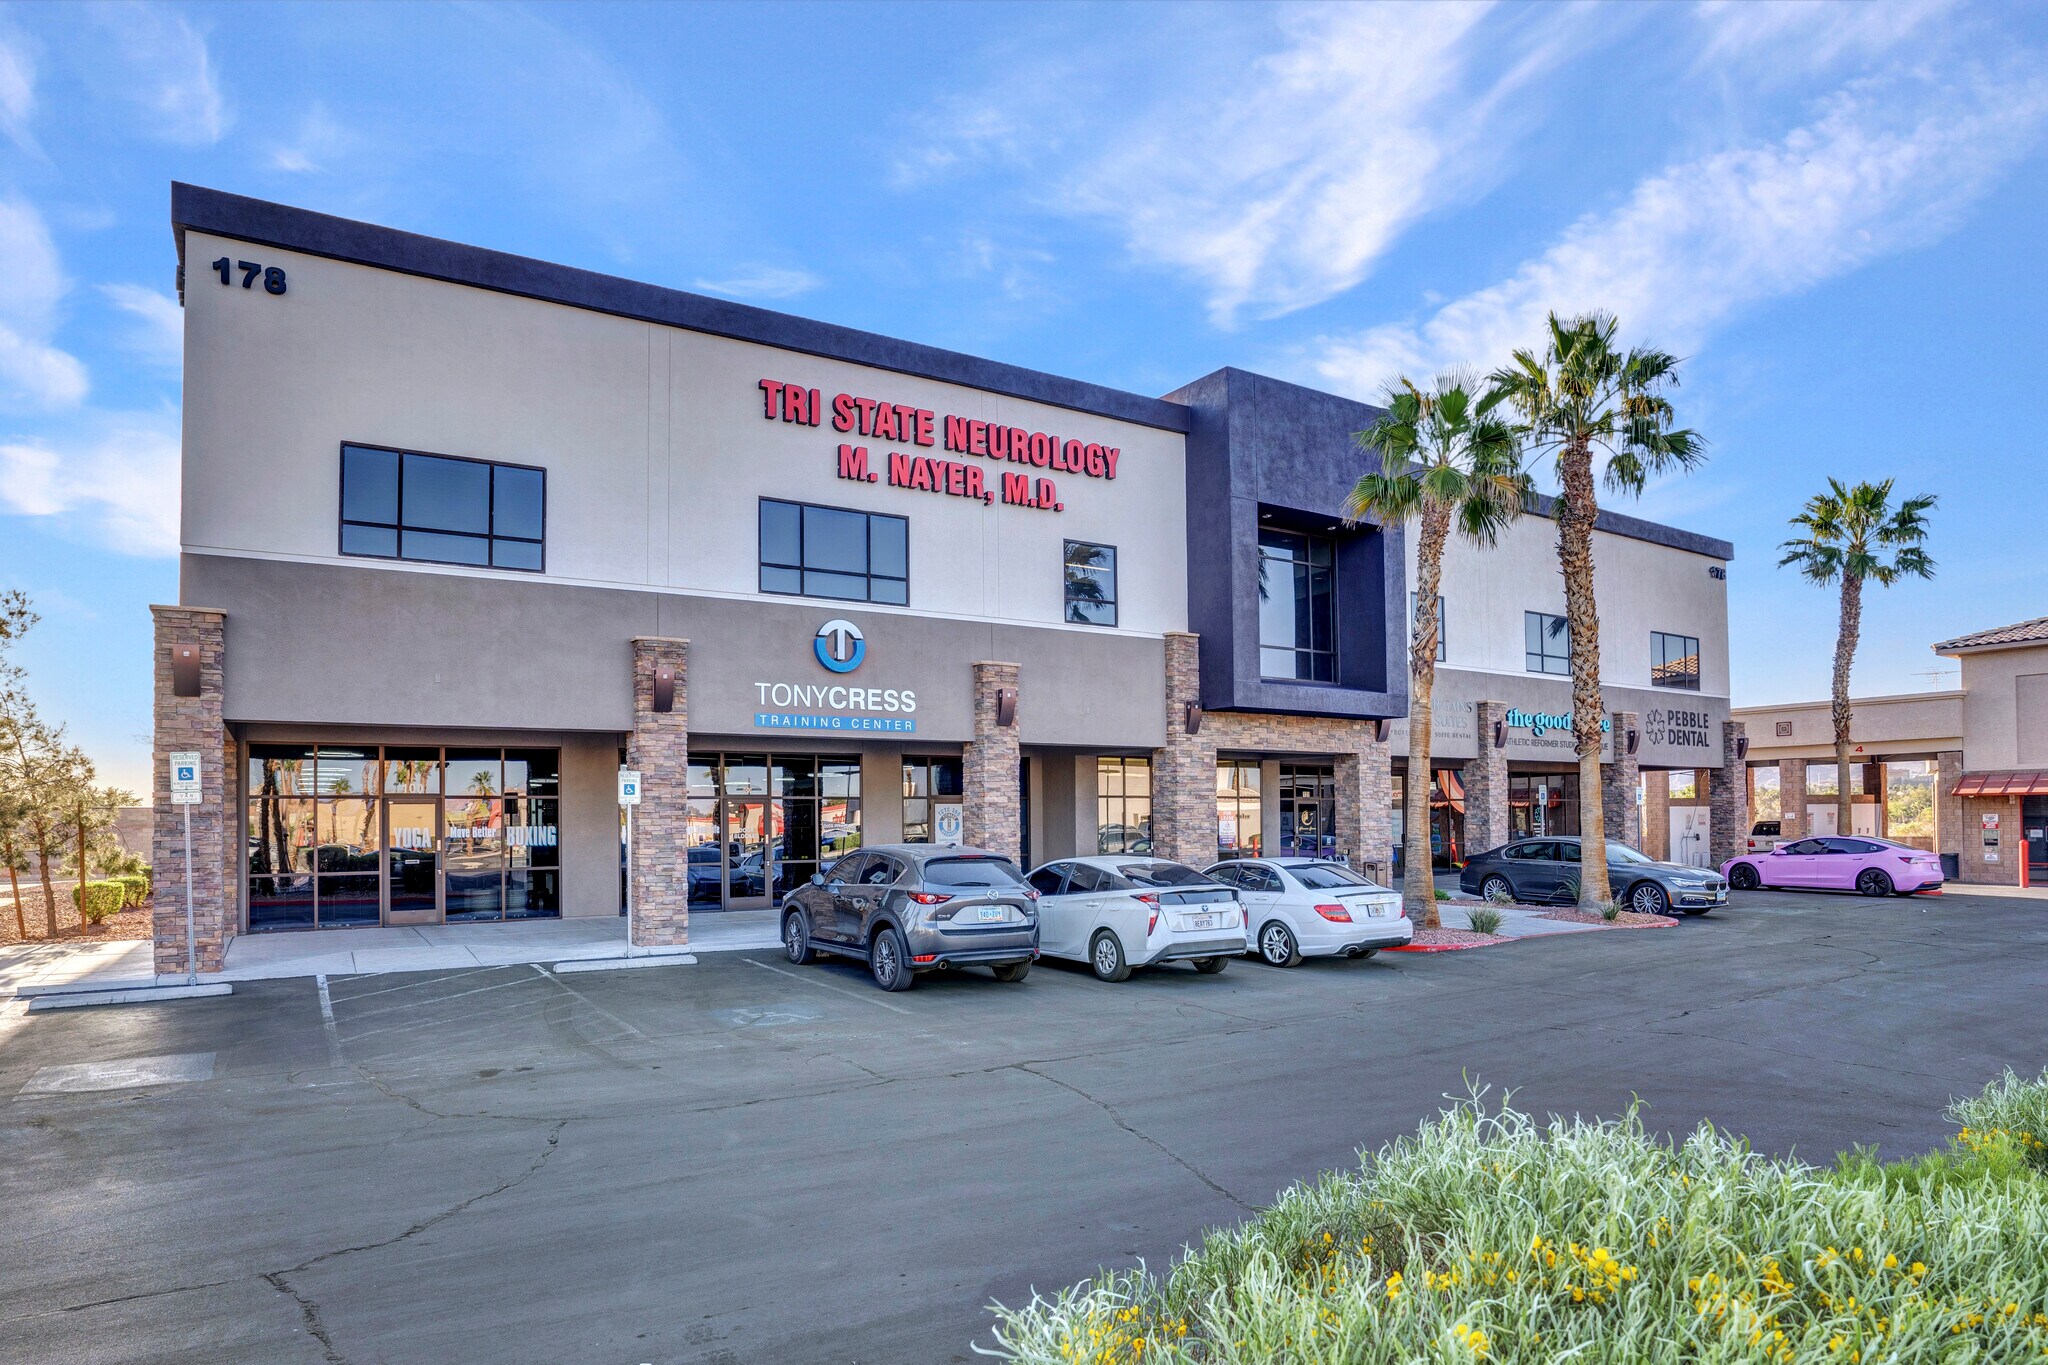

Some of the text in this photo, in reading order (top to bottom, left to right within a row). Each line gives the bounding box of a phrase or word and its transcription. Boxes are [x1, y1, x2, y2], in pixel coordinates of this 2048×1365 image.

[213, 257, 287, 295] 178
[759, 379, 1120, 480] TRI STATE NEUROLOGY
[842, 444, 1065, 512] M. NAYER, M.D.
[755, 682, 917, 713] TONYCRESS
[759, 714, 912, 731] TRAINING CENTER
[1506, 707, 1533, 728] the
[1532, 711, 1574, 737] good
[1667, 709, 1709, 729] PEBBLE
[1531, 739, 1559, 748] REFORMER
[1668, 729, 1709, 747] DENTAL
[402, 783, 424, 794] 100
[394, 826, 432, 848] YOGA
[450, 826, 497, 839] Move Better
[506, 825, 557, 847] BOXING
